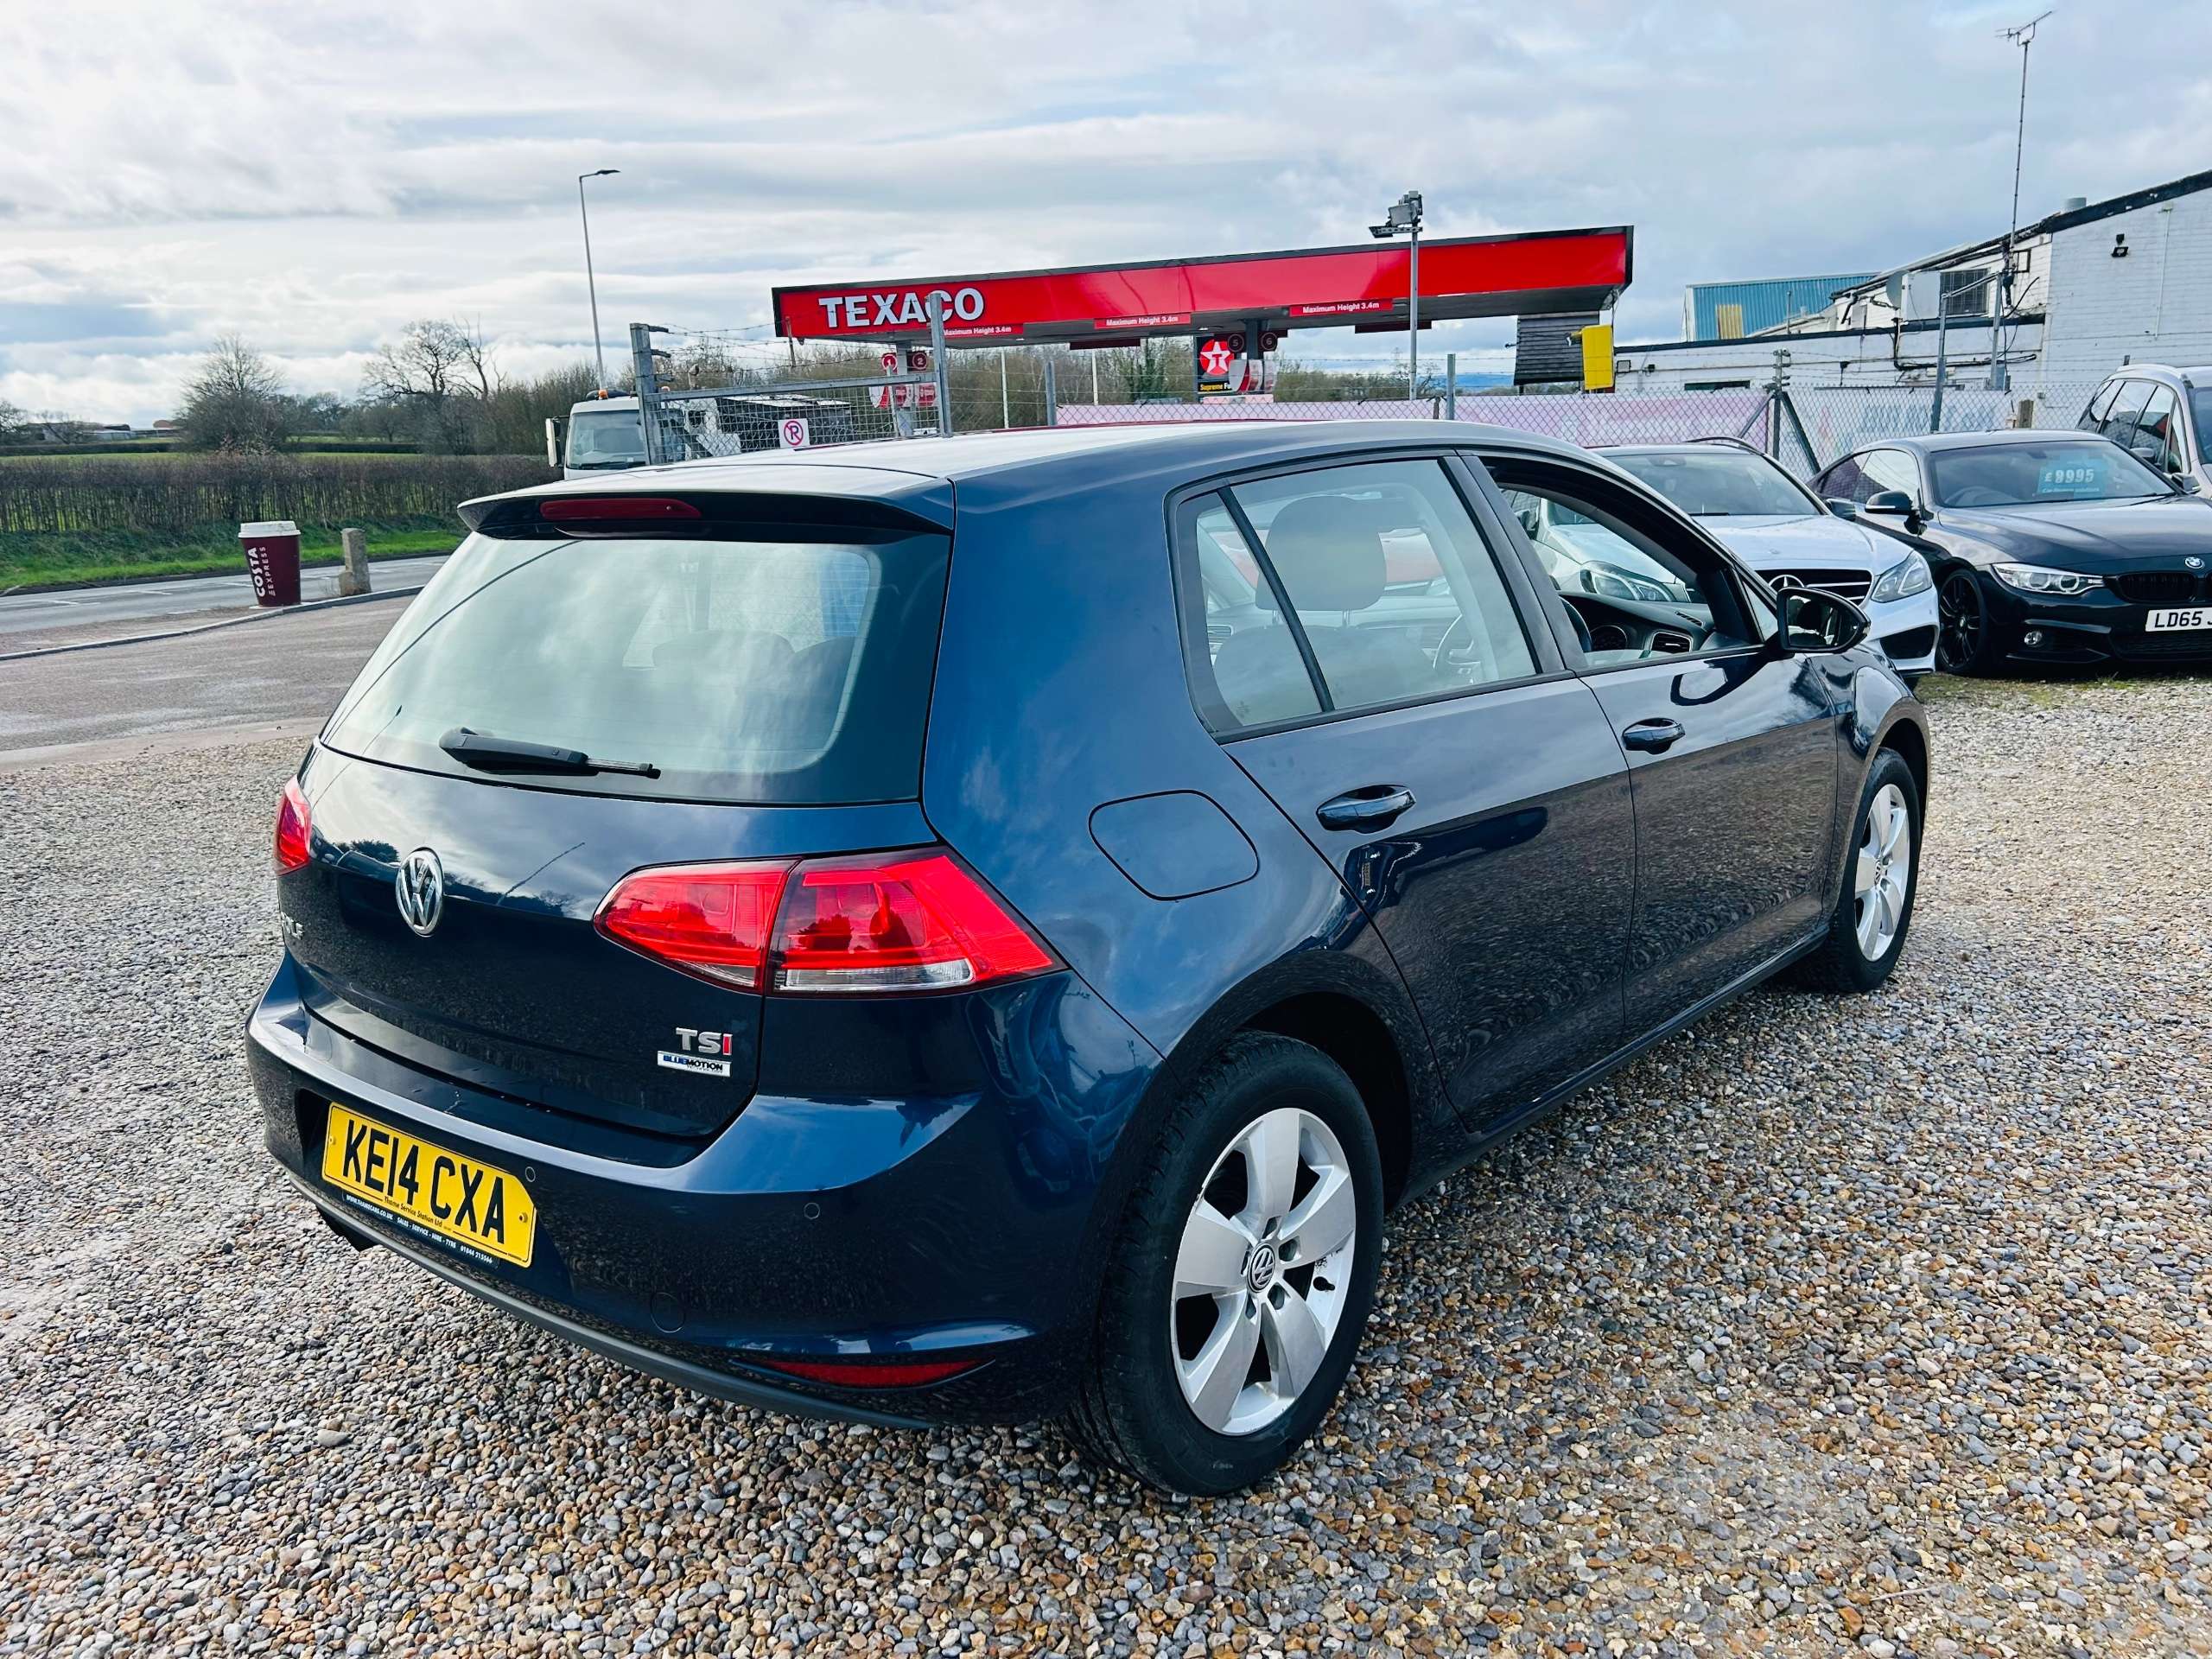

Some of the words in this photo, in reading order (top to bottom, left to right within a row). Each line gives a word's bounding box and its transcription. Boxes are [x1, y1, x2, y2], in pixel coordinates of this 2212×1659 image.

[818, 288, 984, 328] TEXACO
[1337, 303, 1360, 312] Height
[973, 327, 995, 335] Height
[1138, 316, 1160, 326] Height
[248, 547, 265, 597] COSTA
[259, 546, 274, 589] EXPRESS
[2154, 611, 2203, 628] LD65
[676, 1027, 733, 1056] TSI
[342, 1119, 419, 1205] KE14
[430, 1155, 505, 1244] CXA
[397, 1217, 410, 1228] SALES
[411, 1224, 429, 1236] SERVICE
[401, 1203, 417, 1217] Service
[417, 1210, 434, 1224] Station
[435, 1219, 443, 1228] Ltd
